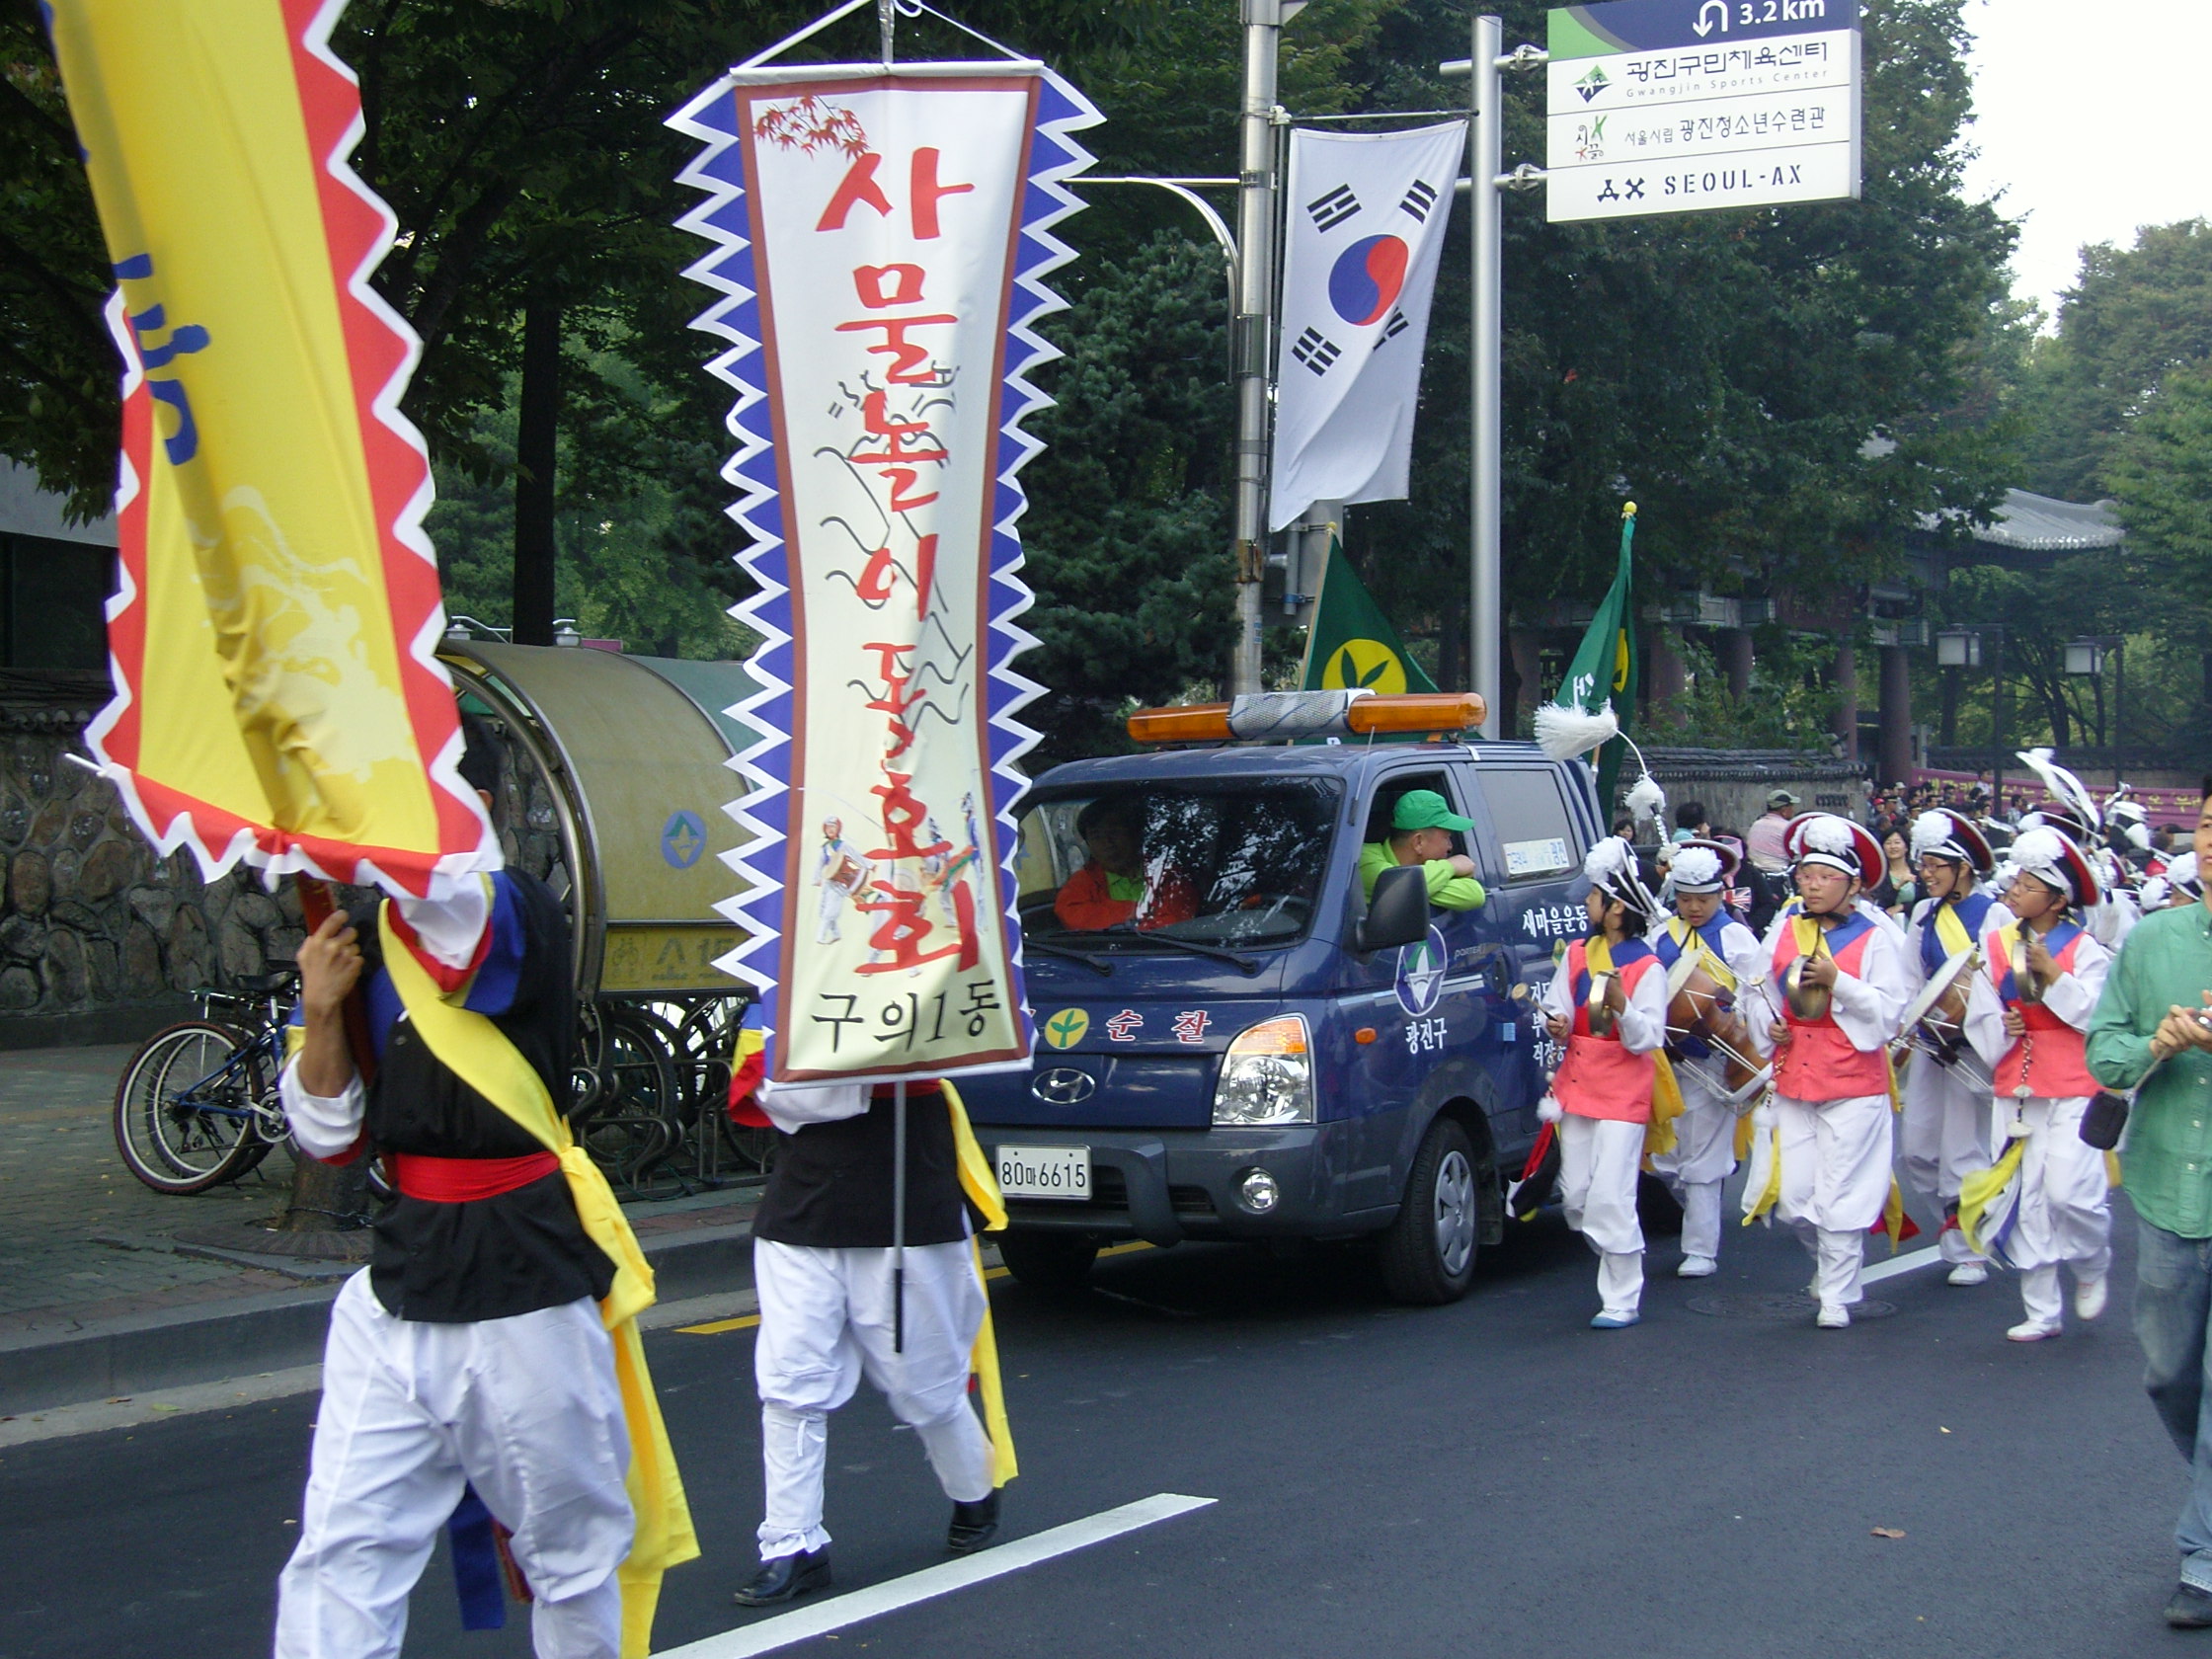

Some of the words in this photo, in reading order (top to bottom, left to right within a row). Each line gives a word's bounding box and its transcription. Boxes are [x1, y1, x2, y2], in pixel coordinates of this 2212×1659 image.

[1739, 0, 1778, 25] 3.2
[1782, 0, 1825, 22] km
[1626, 41, 1828, 83] 광진구민체육센터
[1626, 81, 1700, 98] Gwangjin
[1710, 75, 1763, 90] Sports
[1774, 69, 1829, 83] Center
[1624, 127, 1674, 146] 서울시립
[1680, 106, 1826, 142] 광진청소년수련관
[1664, 164, 1803, 196] SEOUL-AX
[1522, 905, 1589, 938] 새마을운동
[811, 978, 1001, 1054] 구의1동
[1404, 1017, 1448, 1055] 광진구
